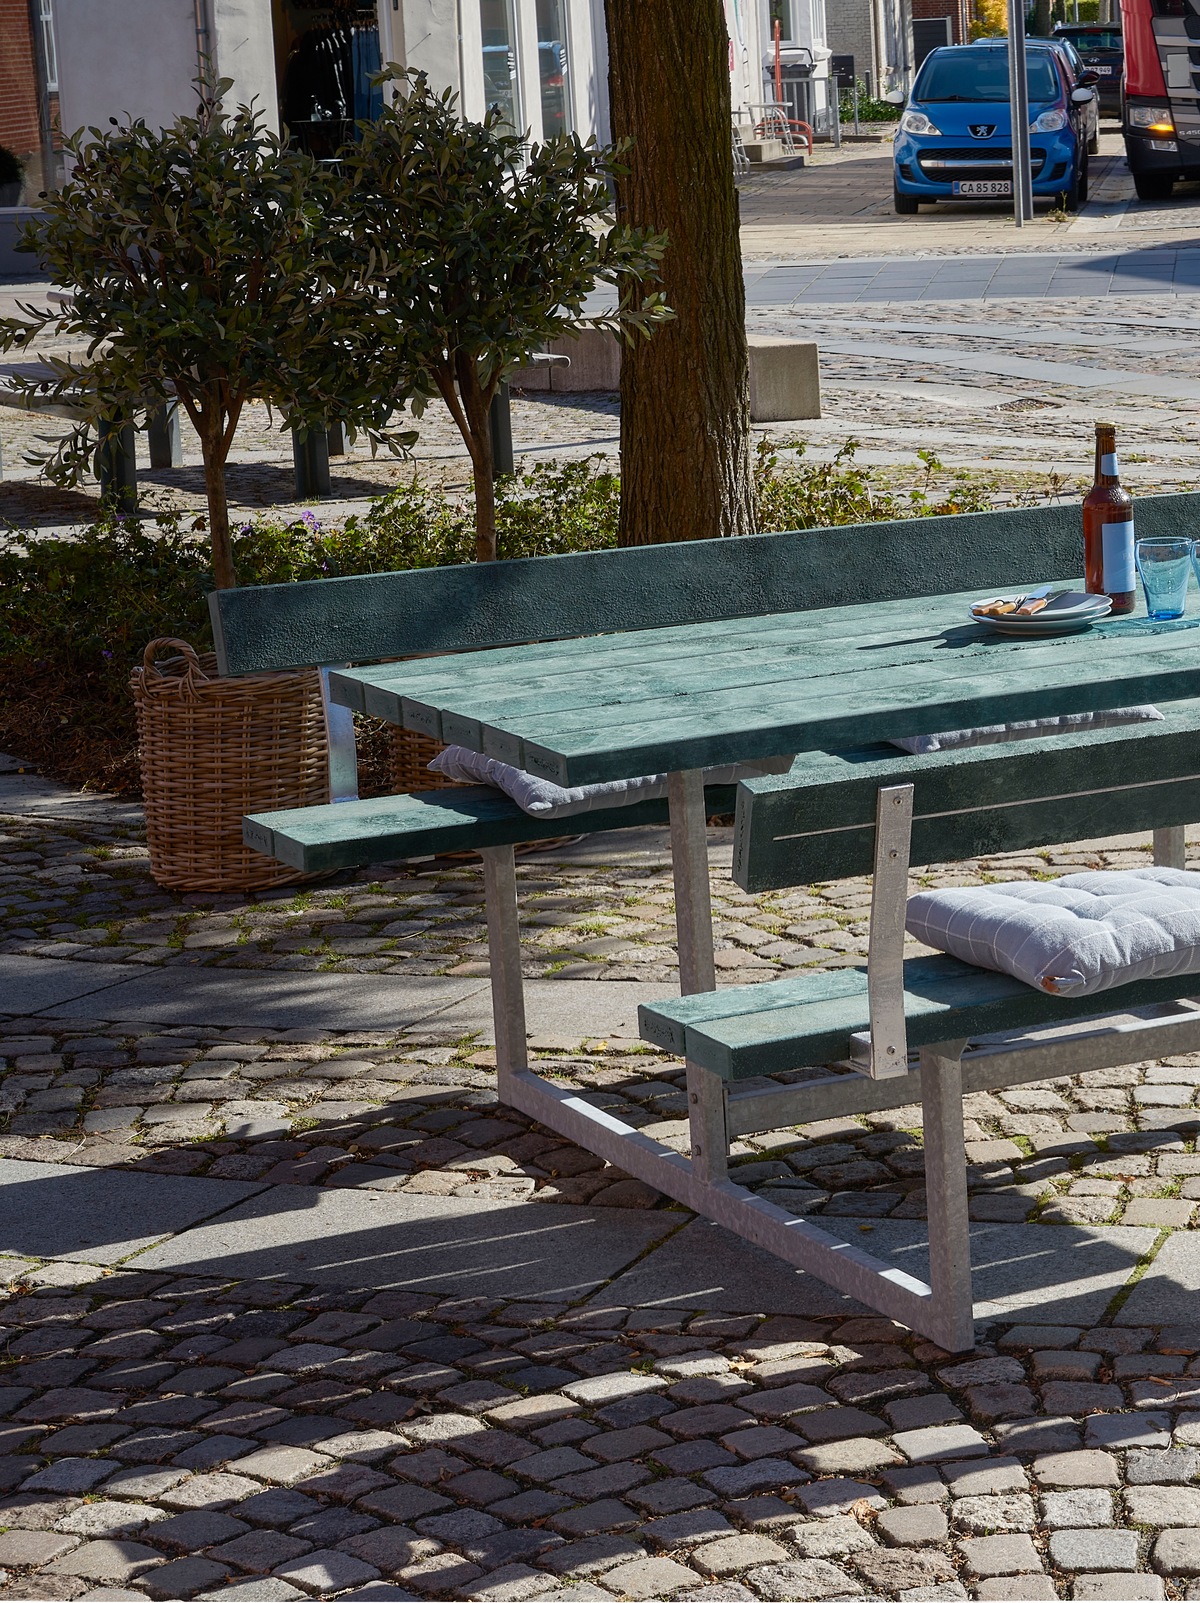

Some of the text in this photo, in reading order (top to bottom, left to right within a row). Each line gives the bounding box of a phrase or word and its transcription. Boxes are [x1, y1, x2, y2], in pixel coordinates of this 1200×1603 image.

[960, 182, 1009, 193] CA 85 828
